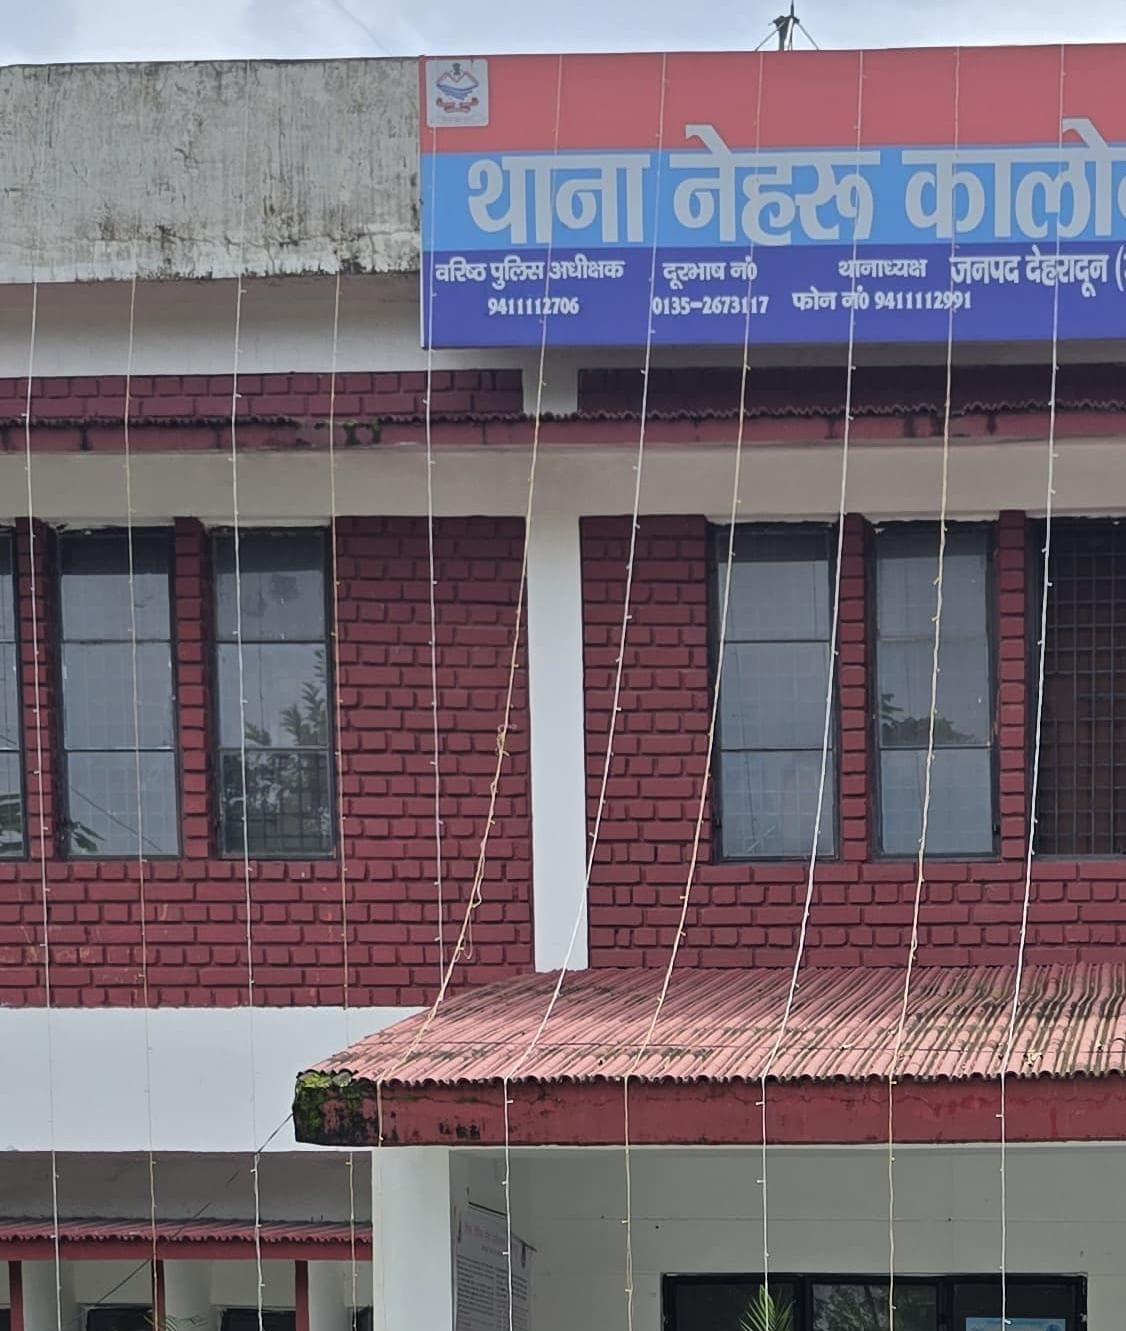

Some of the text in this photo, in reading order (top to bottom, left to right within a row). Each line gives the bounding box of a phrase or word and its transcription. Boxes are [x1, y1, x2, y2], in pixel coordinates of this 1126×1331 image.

[467, 153, 651, 245] थाना
[669, 124, 881, 247] नेहरू
[435, 254, 625, 290] वरिष्ठ पुलिस अधीक्षक
[663, 262, 726, 290] दूरभाष
[838, 259, 927, 279] थानाध्यक्ष
[950, 256, 1020, 284] जनपद
[1024, 245, 1109, 297] देहरादून
[487, 297, 580, 316] 9411112706
[652, 296, 769, 315] 0135-2673117
[792, 286, 836, 311] फोन
[874, 290, 972, 310] 9411112991
